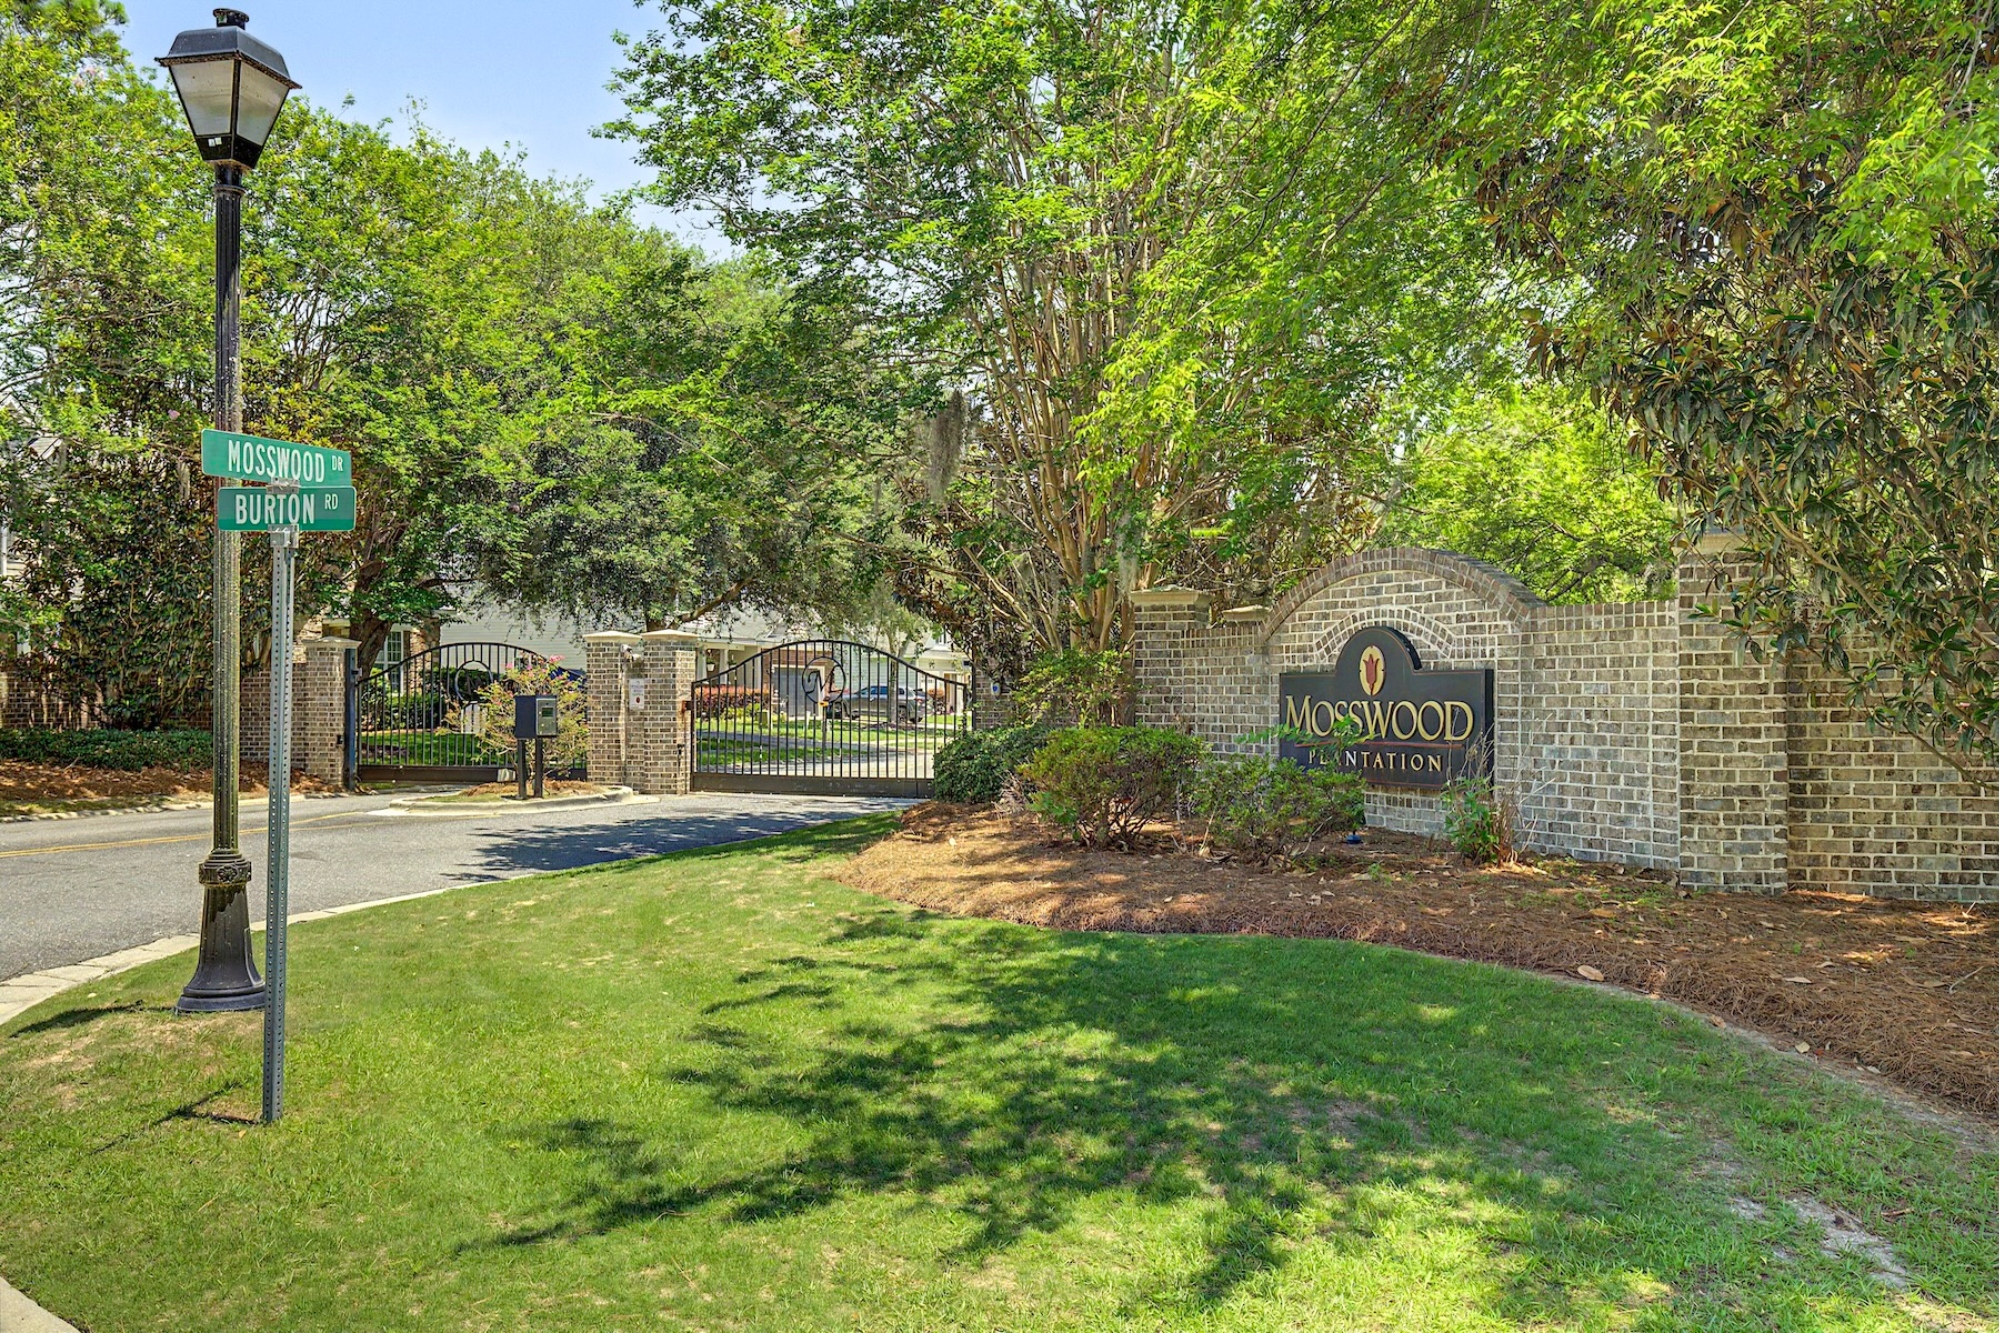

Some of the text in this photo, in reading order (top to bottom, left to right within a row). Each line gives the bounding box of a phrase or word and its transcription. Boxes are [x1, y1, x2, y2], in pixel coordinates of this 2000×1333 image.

[228, 440, 344, 483] MOSSWOOD DR
[235, 493, 339, 525] BURTON RD
[1308, 750, 1442, 772] PLNTATION
